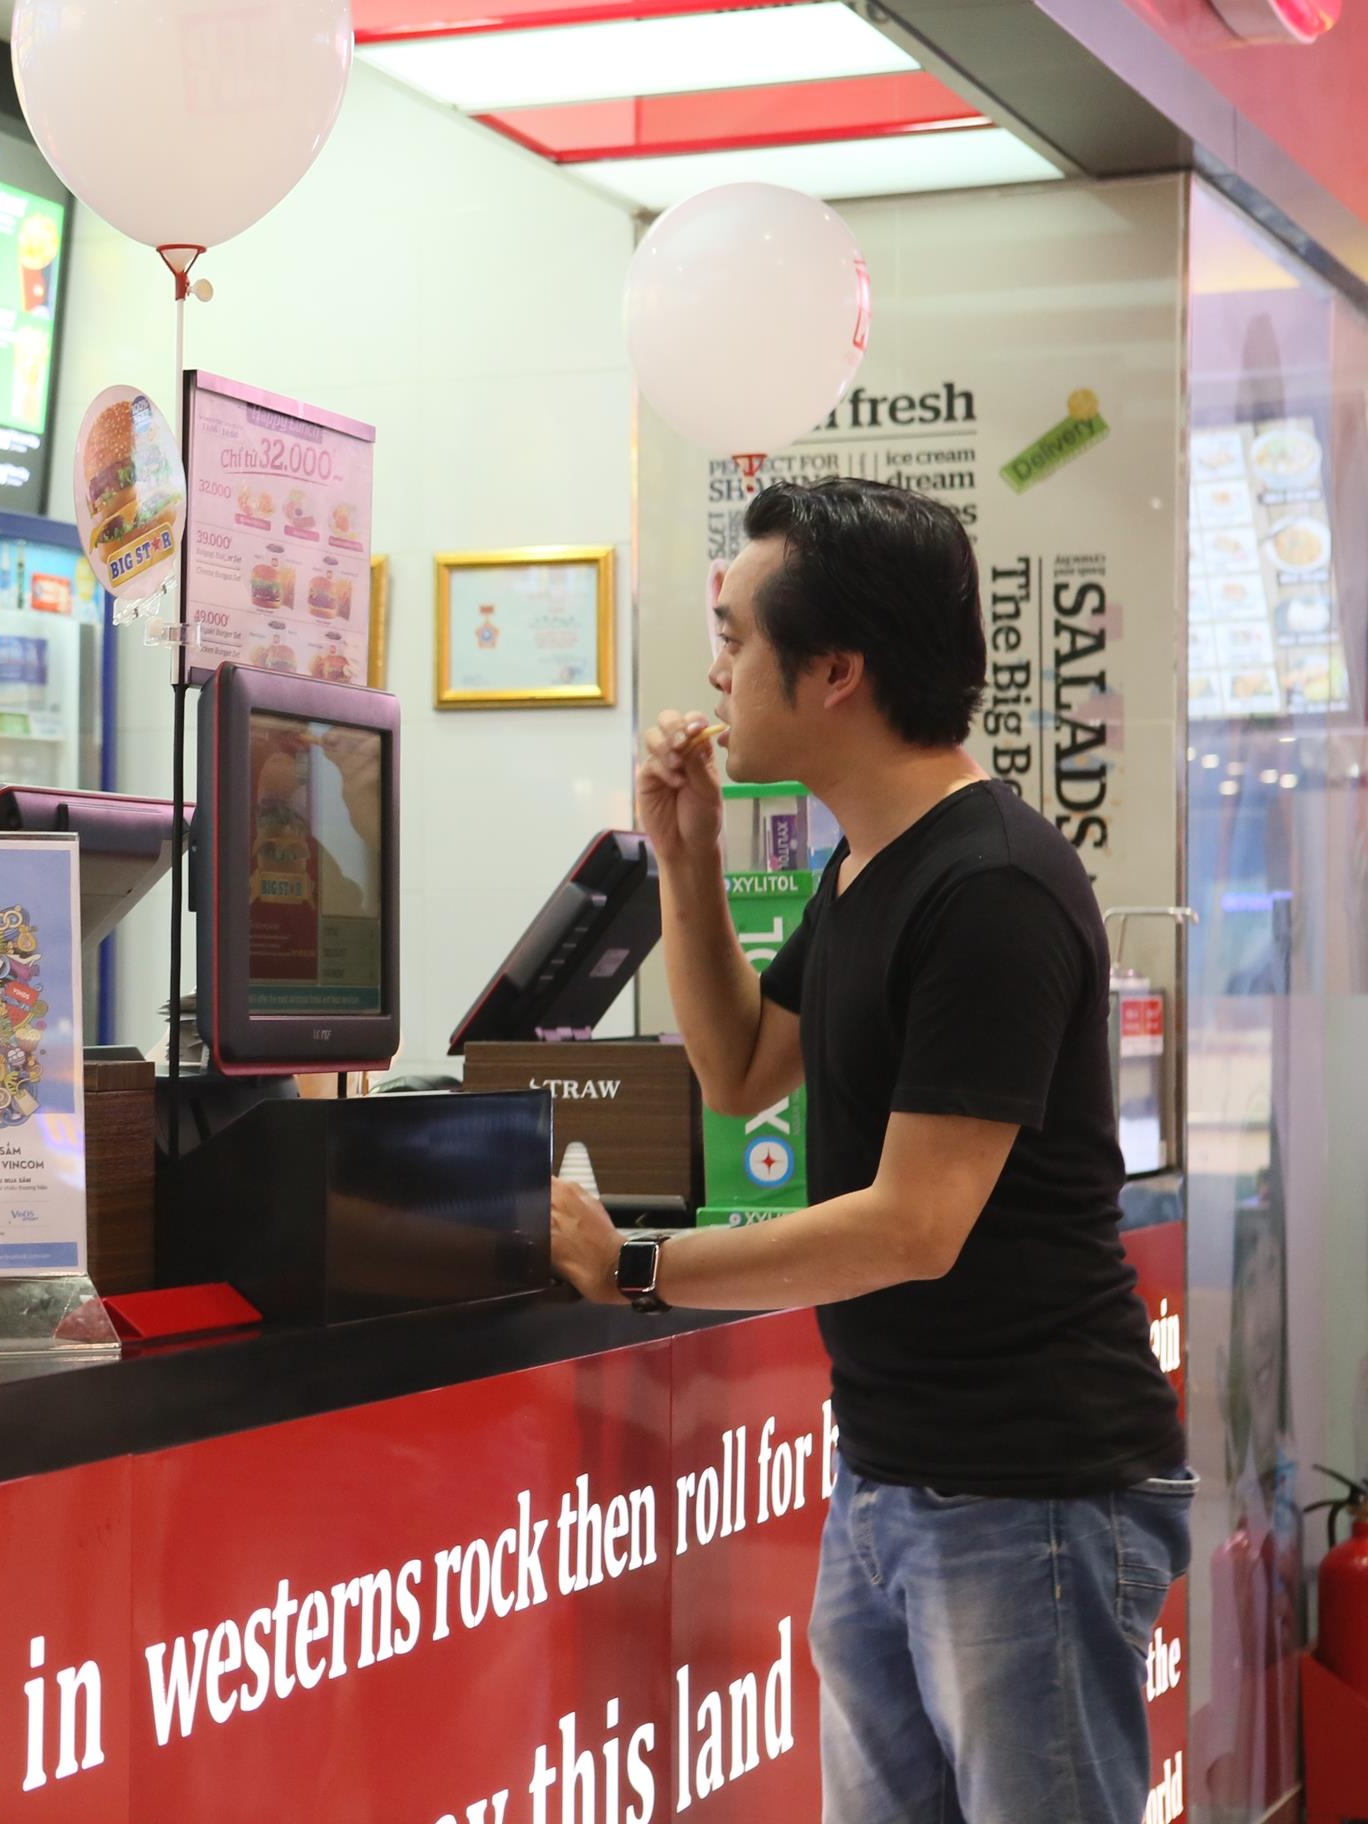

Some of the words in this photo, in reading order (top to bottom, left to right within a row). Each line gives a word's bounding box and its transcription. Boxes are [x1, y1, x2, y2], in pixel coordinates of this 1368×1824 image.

[850, 382, 977, 428] fresh
[259, 438, 333, 481] 32.000
[800, 454, 839, 472] FOR
[886, 455, 913, 467] ice
[917, 449, 976, 465] cream
[1013, 416, 1096, 481] Delivery
[110, 552, 134, 579] BIG
[991, 556, 1031, 652] The
[983, 661, 1032, 737] Big
[1053, 582, 1109, 848] SALADS
[732, 875, 799, 893] XYLITOL
[0, 1142, 22, 1155] SẮM
[1, 1160, 45, 1170] VINCOM
[22, 1636, 105, 1792] in
[145, 1559, 422, 1746] westerns
[433, 1489, 549, 1641] rock
[557, 1473, 657, 1596] then
[676, 1426, 746, 1556] roll
[757, 1416, 813, 1524] for
[1145, 1627, 1181, 1702] the
[528, 1697, 655, 1824] this
[676, 1615, 794, 1813] land
